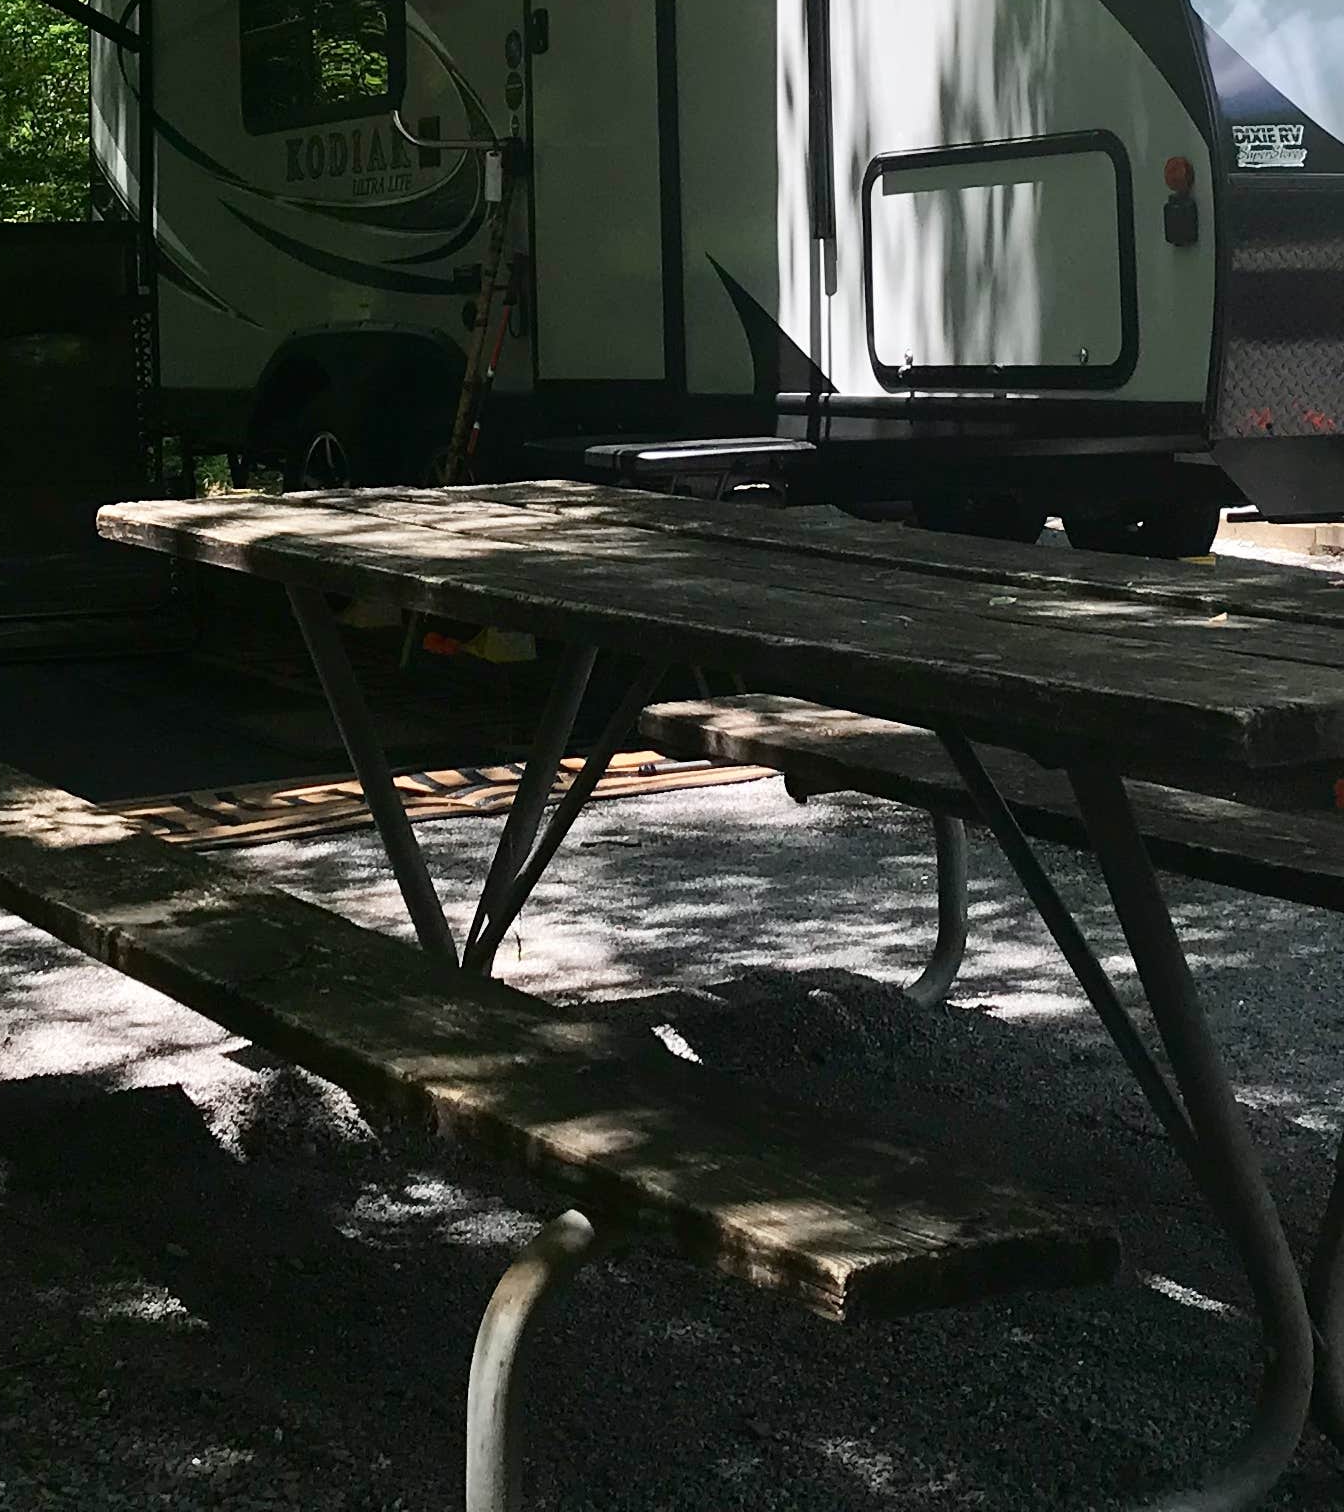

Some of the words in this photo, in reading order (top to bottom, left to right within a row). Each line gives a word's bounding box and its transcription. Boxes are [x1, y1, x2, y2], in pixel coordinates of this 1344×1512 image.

[1233, 126, 1276, 144] DIXIE
[1279, 126, 1301, 144] RV
[286, 126, 412, 182] KODIAK
[352, 177, 385, 197] ULTRA
[388, 173, 413, 193] LITE
